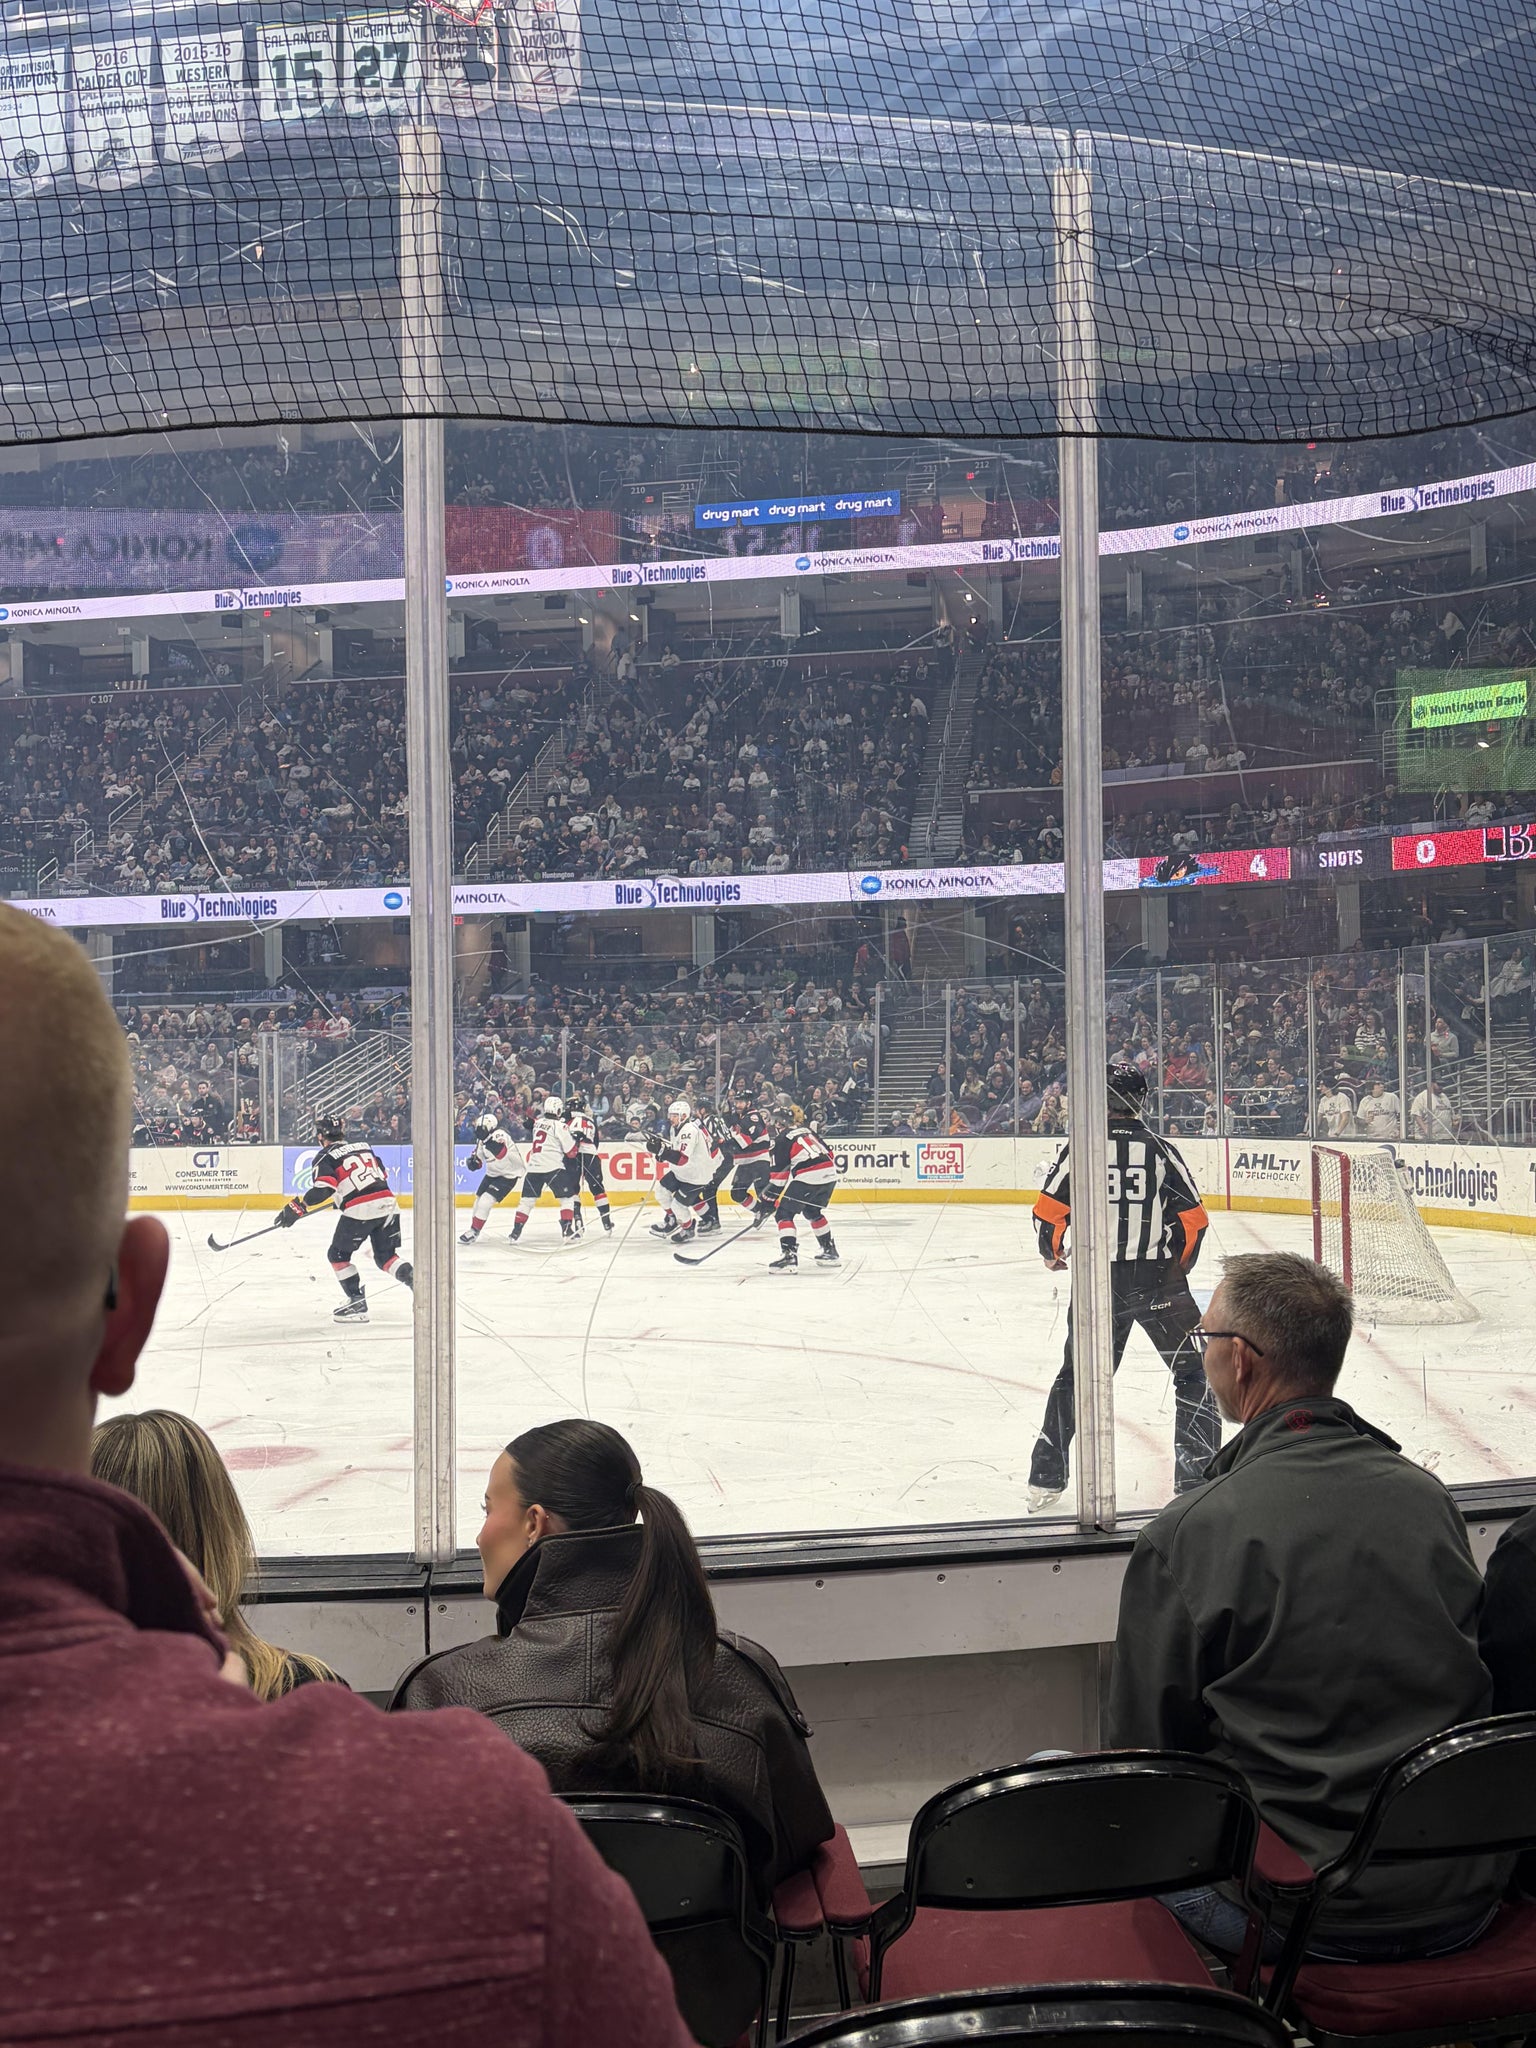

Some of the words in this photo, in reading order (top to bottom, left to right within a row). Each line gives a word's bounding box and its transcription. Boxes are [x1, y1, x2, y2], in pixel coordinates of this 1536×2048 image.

[532, 17, 556, 29] EAST
[264, 30, 330, 48] CALLANDER
[522, 31, 568, 45] DIVISION
[95, 51, 128, 67] 2016
[174, 43, 232, 61] 2015-16
[514, 44, 575, 63] CHAMPIONS
[175, 64, 231, 83] WESTERN
[354, 42, 410, 95] 27
[78, 73, 121, 91] CALDER
[125, 69, 148, 87] CUP
[272, 50, 323, 110] 15
[79, 97, 149, 120] CHAMPIONS
[171, 107, 238, 126] CHAMPIONS
[681, 483, 695, 491] 211
[835, 500, 862, 512] drug
[865, 497, 892, 508] mart
[1380, 495, 1405, 513] Blue
[1418, 479, 1496, 508] Technologies
[703, 510, 729, 521] drug
[732, 507, 759, 518] mart
[769, 505, 795, 517] drug
[797, 502, 826, 513] mart
[1192, 523, 1232, 535] KONICA
[1234, 515, 1279, 530] MINOLTA
[982, 544, 1003, 560] Blue
[1014, 540, 1060, 558] Technolo
[814, 557, 851, 568] KONICA
[853, 554, 895, 564] MINOLTA
[612, 568, 632, 584] Blue
[643, 563, 706, 583] Technologies
[455, 580, 489, 590] KONICA
[491, 577, 530, 588] MINOLTA
[215, 593, 234, 608] Blue
[243, 589, 302, 608] Technologies
[11, 608, 43, 617] KONICA
[45, 606, 81, 615] MINOLTA
[771, 659, 788, 668] 109
[90, 696, 97, 704] C
[98, 695, 114, 704] 107
[1430, 699, 1493, 716] Huntington
[1496, 694, 1525, 707] Bank
[1319, 849, 1363, 868] SHOTS
[1416, 840, 1436, 864] 0
[1249, 854, 1268, 878] 4
[296, 879, 328, 887] Huntington
[542, 872, 575, 880] Huntington
[886, 878, 935, 889] KONICA
[938, 876, 994, 887] MINOLTA
[59, 888, 89, 896] Huntington
[454, 893, 506, 904] MINOLTA
[615, 884, 642, 904] Blue
[657, 881, 741, 904] Technologies
[161, 899, 186, 918] Blue
[199, 896, 277, 919] Technologies
[533, 1130, 547, 1153] 2
[828, 1144, 876, 1152] DISCOUNT
[854, 1151, 910, 1168] mart
[921, 1143, 956, 1164] drug
[175, 1170, 219, 1178] CONSUMER
[924, 1162, 964, 1174] mart
[1232, 1170, 1244, 1179] ON
[1408, 1160, 1498, 1207] echnologies
[1150, 1301, 1171, 1310] CCM
